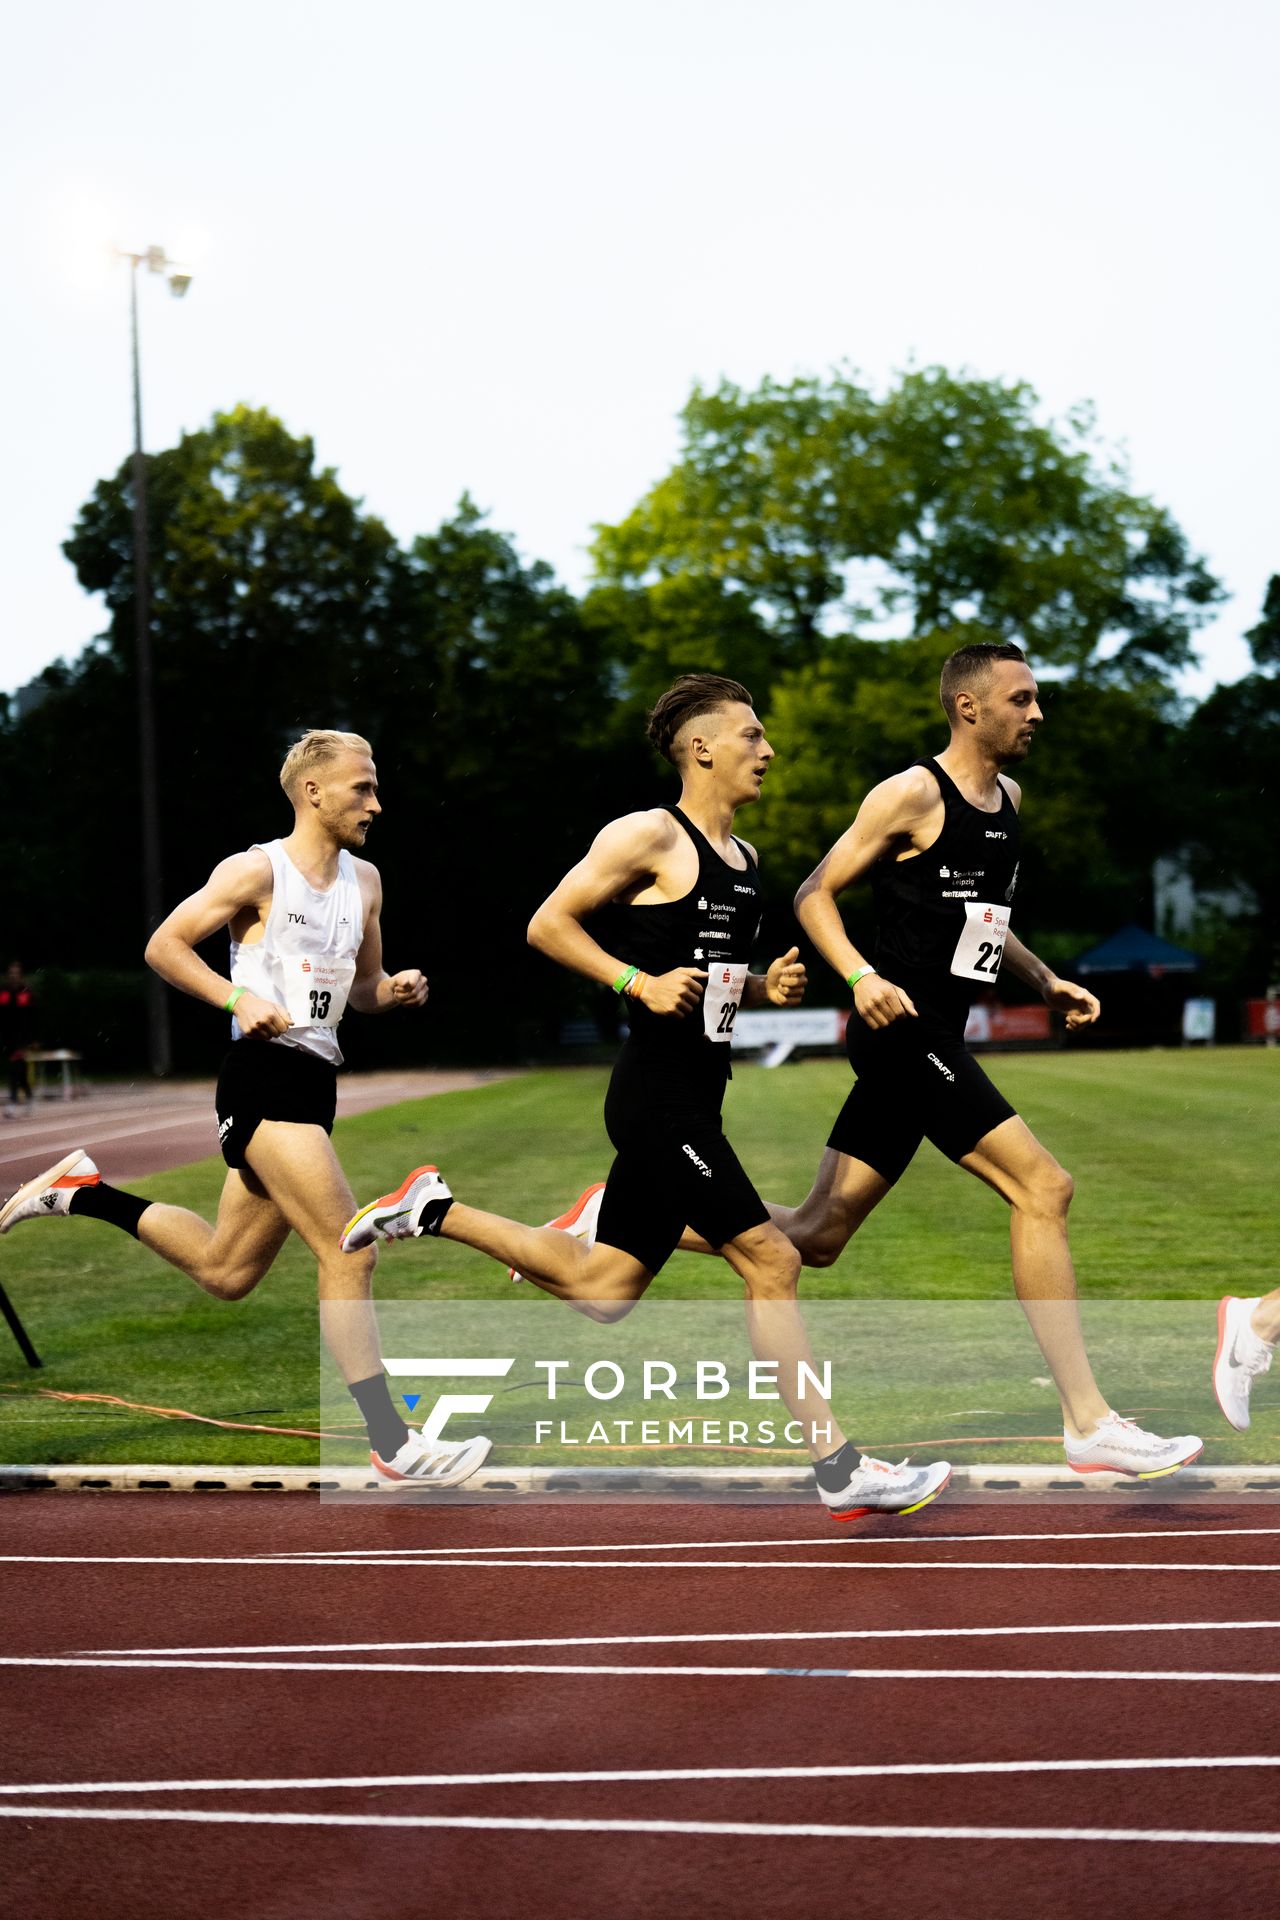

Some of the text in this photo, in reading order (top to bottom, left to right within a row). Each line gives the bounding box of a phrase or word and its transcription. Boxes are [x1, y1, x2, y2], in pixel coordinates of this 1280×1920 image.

[952, 878, 975, 887] Leipzig
[953, 870, 985, 878] Sparkasse
[710, 903, 736, 913] Sparkasse
[287, 913, 307, 925] TVL
[709, 912, 730, 923] Leipzig
[973, 941, 1003, 975] 22
[309, 990, 332, 1020] 33
[717, 1001, 738, 1033] 22
[927, 1052, 952, 1076] CRAFT
[682, 1143, 708, 1170] CRAFT
